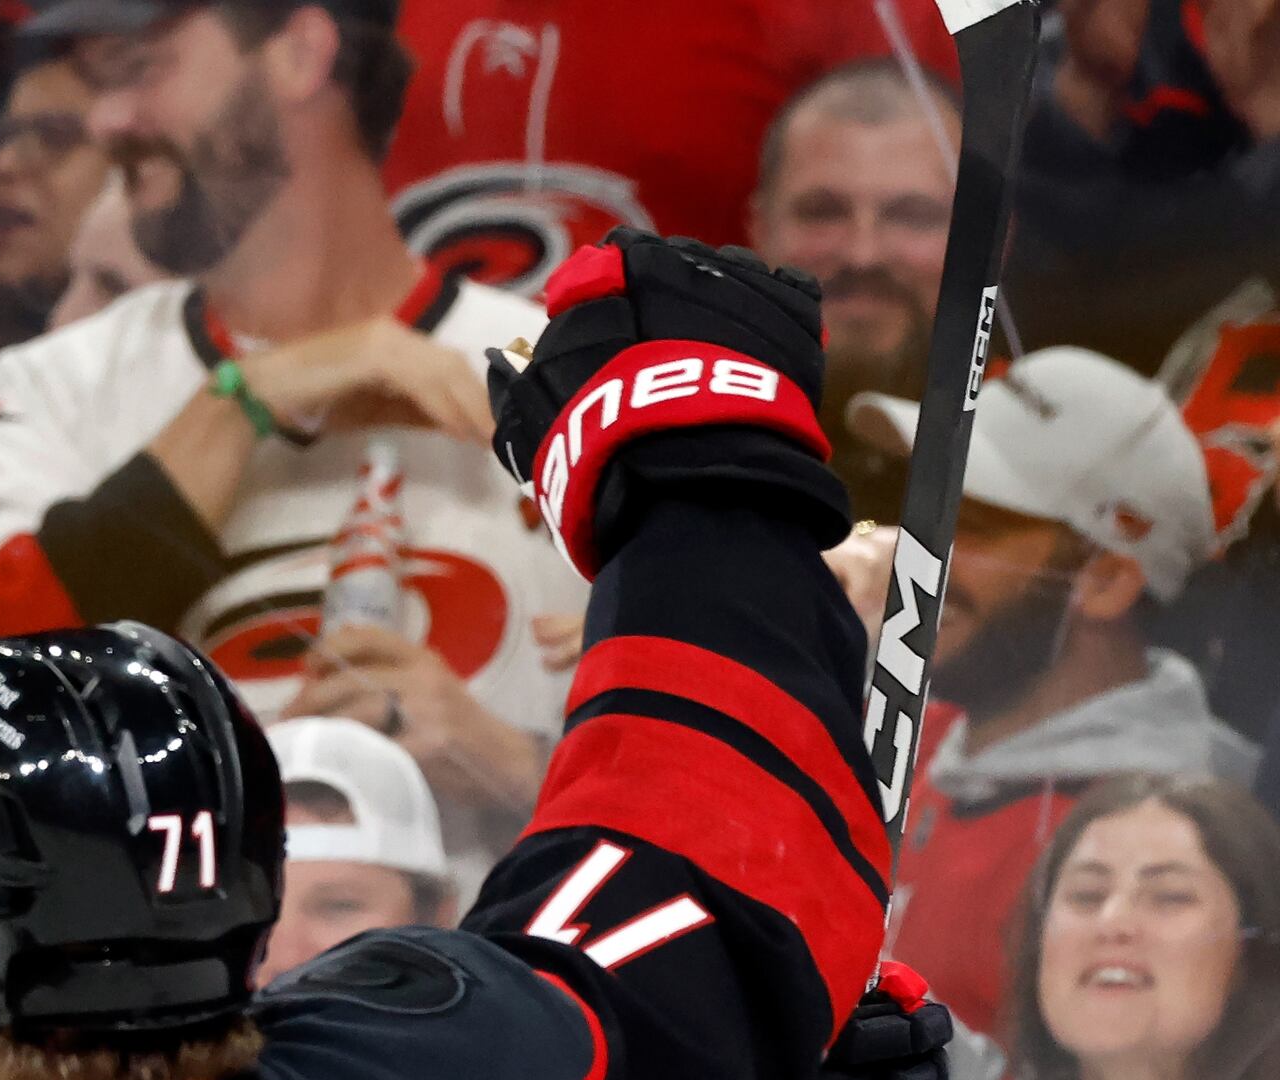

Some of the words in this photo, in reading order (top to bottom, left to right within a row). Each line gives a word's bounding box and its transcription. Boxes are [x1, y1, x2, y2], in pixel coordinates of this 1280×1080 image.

[968, 294, 996, 402] CCM
[863, 526, 942, 824] CM
[147, 809, 216, 893] 71
